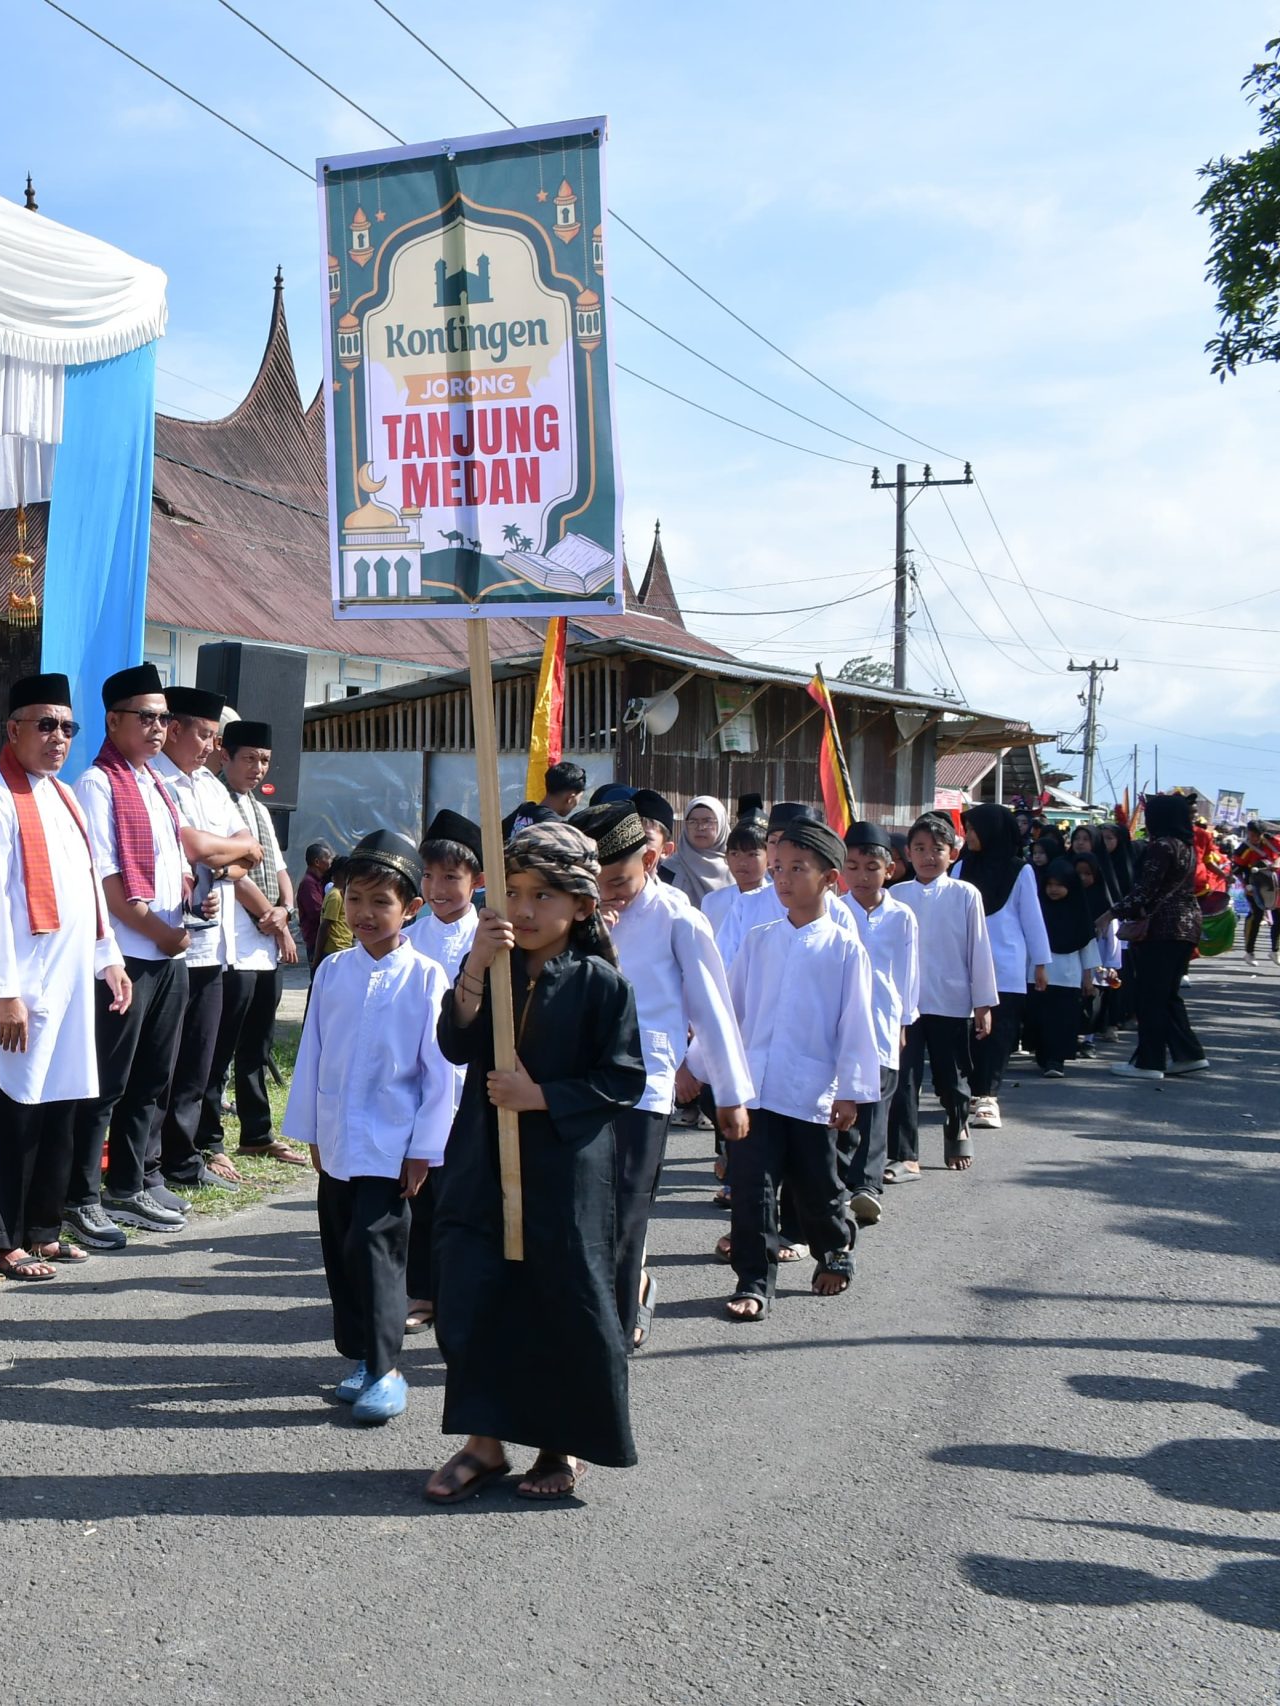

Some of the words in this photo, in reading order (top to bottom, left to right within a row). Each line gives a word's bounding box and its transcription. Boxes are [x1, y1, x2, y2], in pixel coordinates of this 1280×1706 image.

[384, 315, 549, 363] Kontingen
[420, 373, 516, 399] JORONG
[382, 404, 560, 460] TANJUNG
[402, 456, 541, 509] MEDAN
